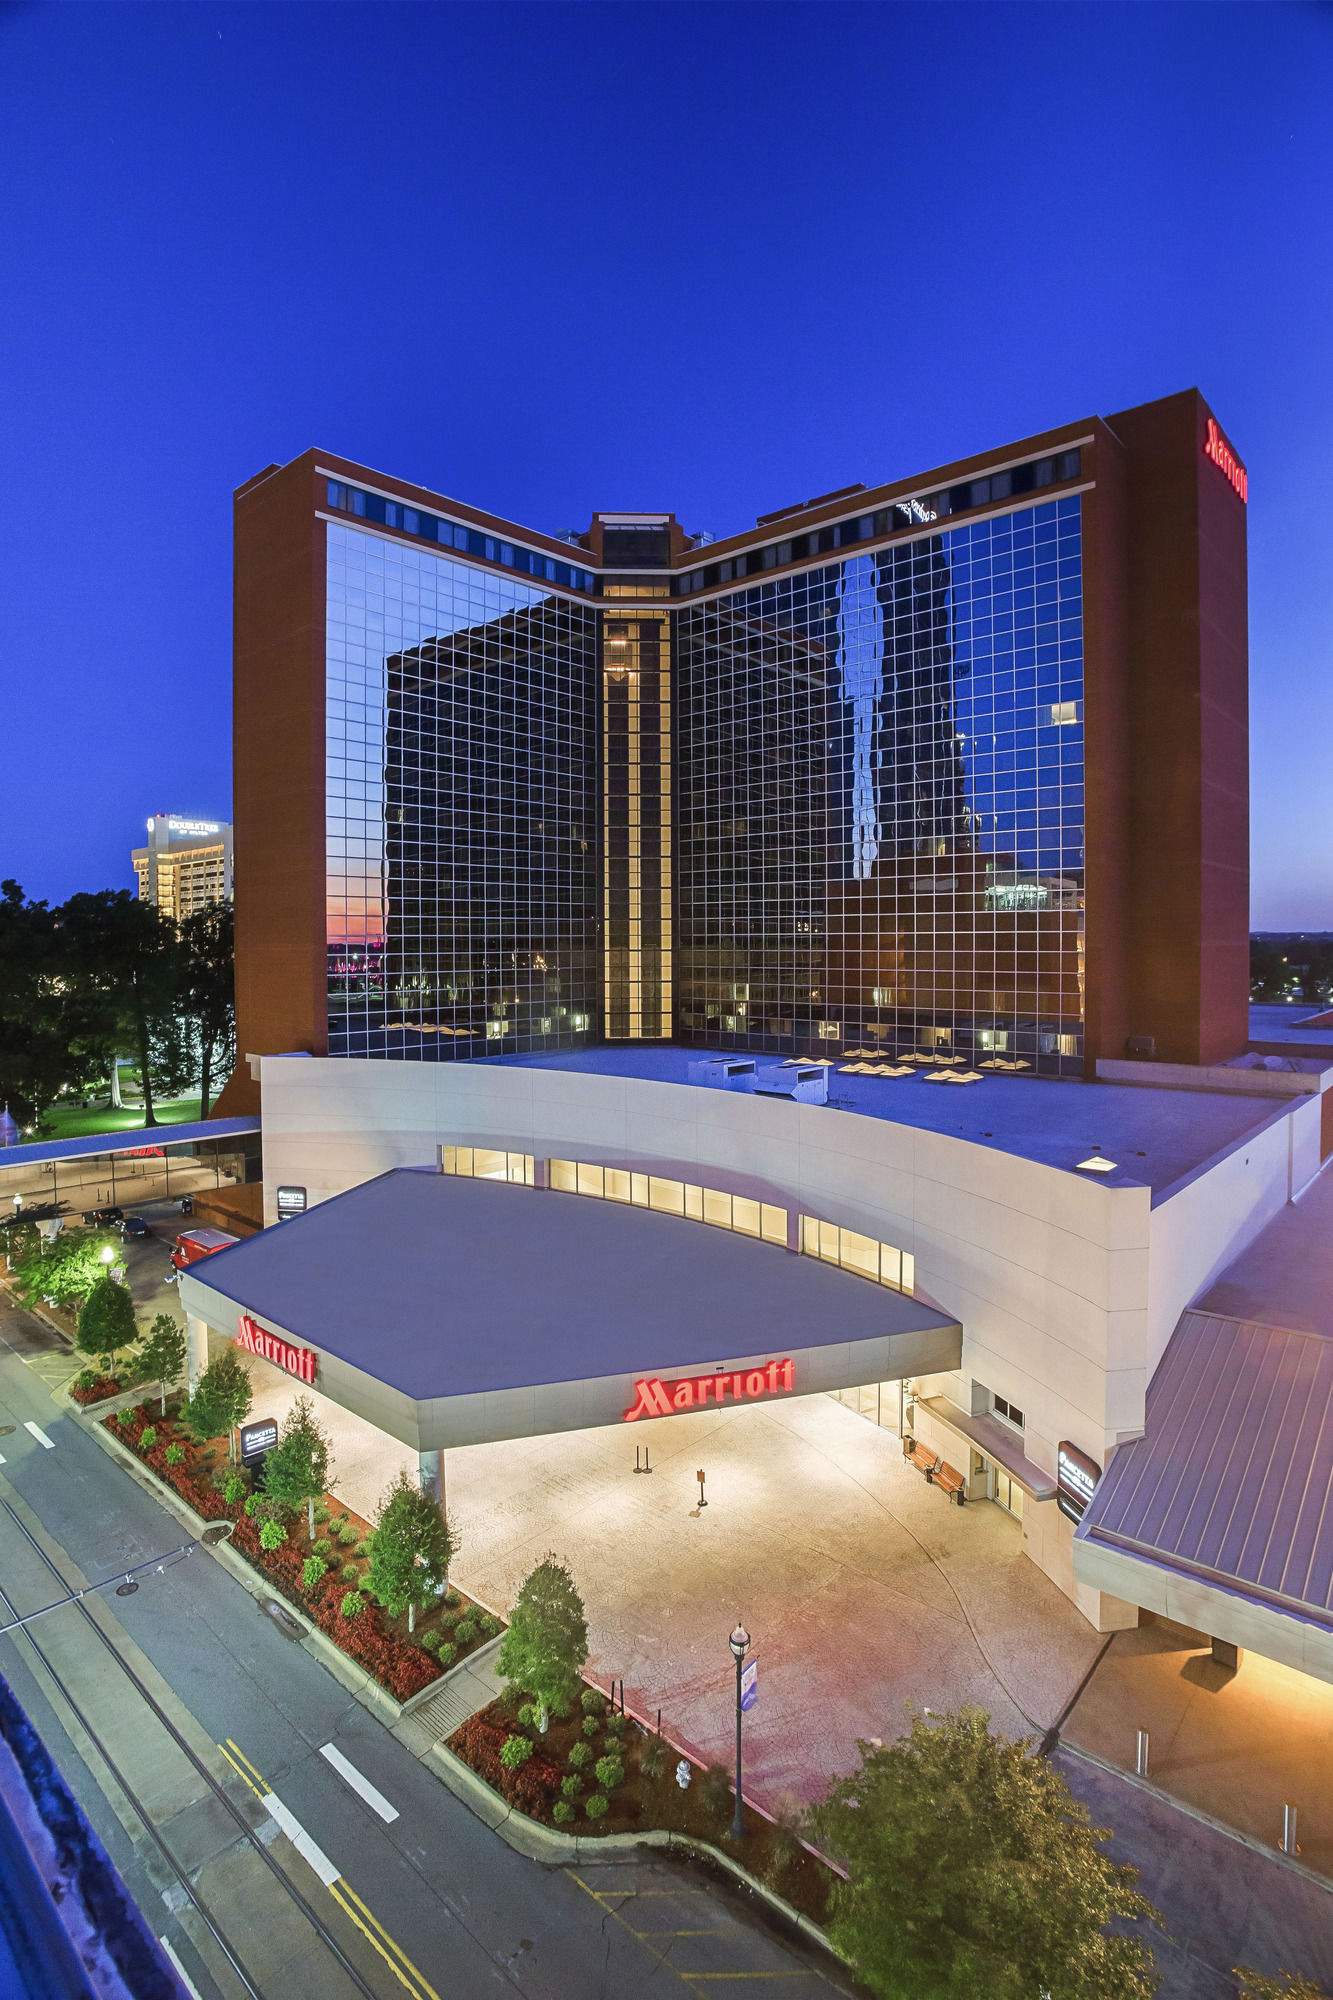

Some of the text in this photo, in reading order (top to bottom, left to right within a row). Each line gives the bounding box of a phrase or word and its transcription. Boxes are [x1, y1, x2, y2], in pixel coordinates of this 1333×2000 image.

[1205, 418, 1247, 504] Marriott
[235, 1316, 315, 1384] Marriott
[623, 1357, 796, 1422] Marriott
